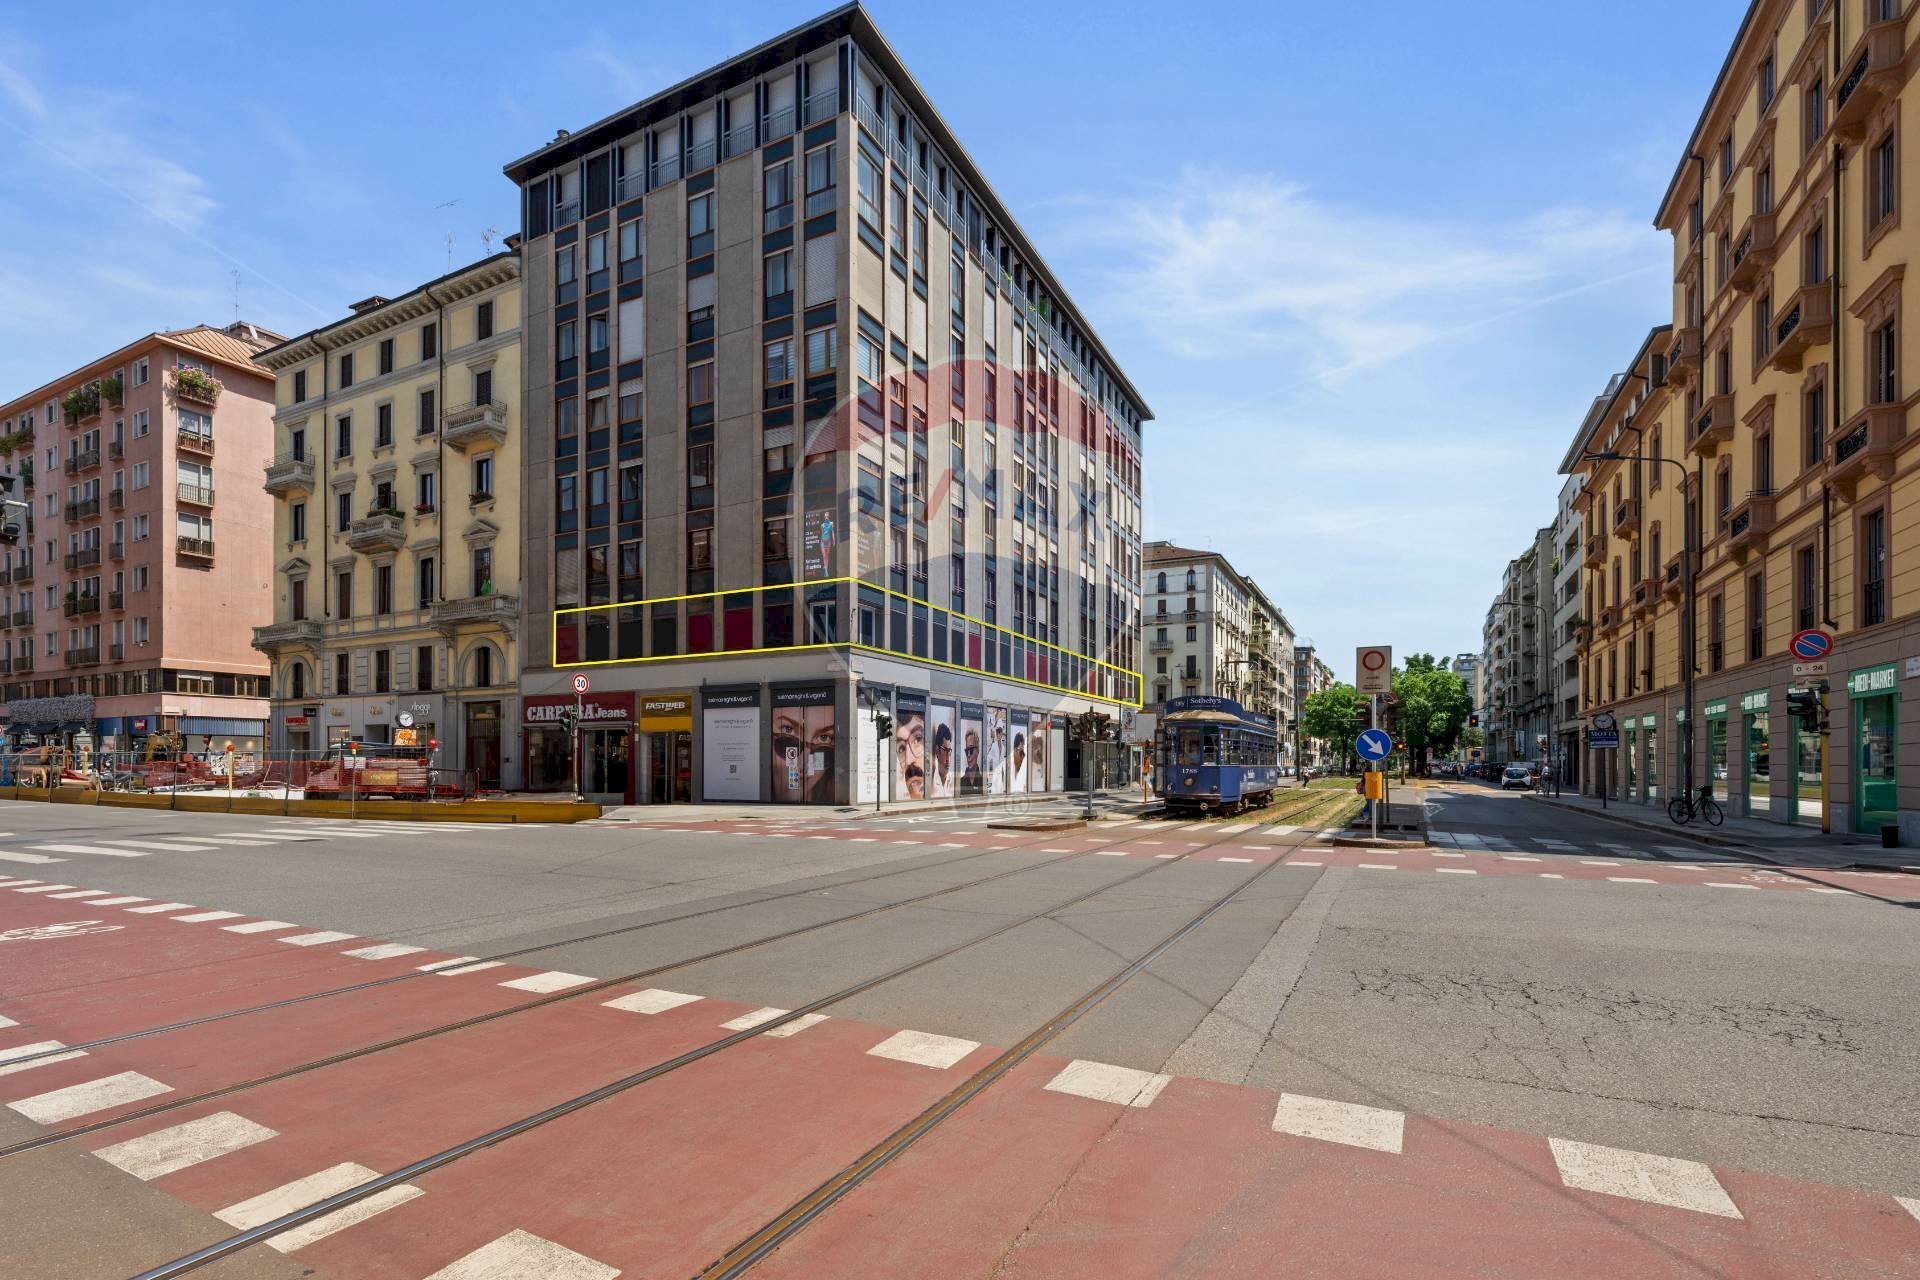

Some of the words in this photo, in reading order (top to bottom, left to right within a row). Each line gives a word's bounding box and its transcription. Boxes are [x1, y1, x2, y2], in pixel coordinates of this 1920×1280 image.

[576, 679, 586, 689] 30
[645, 701, 686, 711] FASTWEB
[1190, 696, 1222, 706] Sotheby's
[595, 707, 628, 719] Jeans
